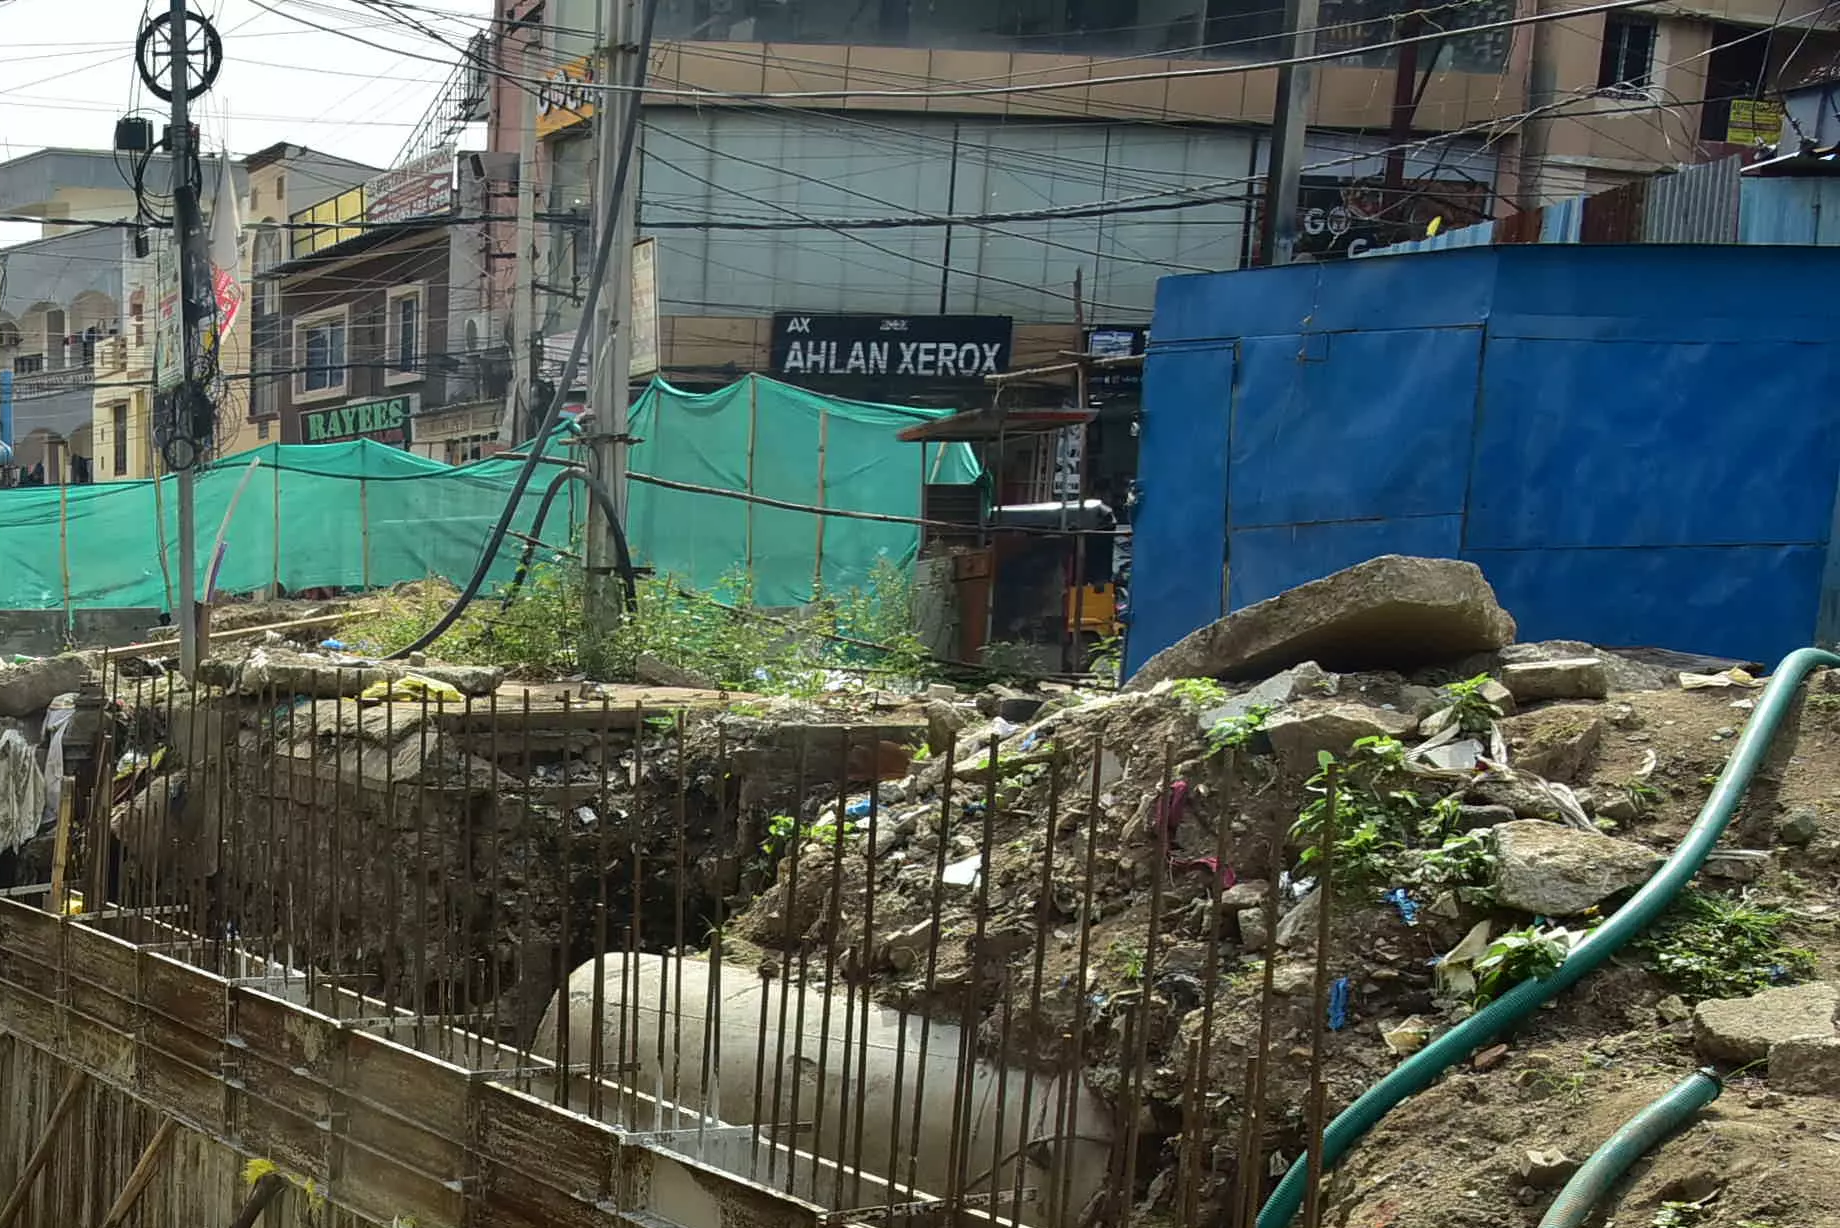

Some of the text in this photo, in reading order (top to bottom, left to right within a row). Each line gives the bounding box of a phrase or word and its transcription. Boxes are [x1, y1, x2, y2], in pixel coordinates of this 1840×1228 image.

[787, 318, 812, 333] AX
[783, 341, 1001, 377] AHLAN XEROX
[308, 399, 405, 441] RAYEES
